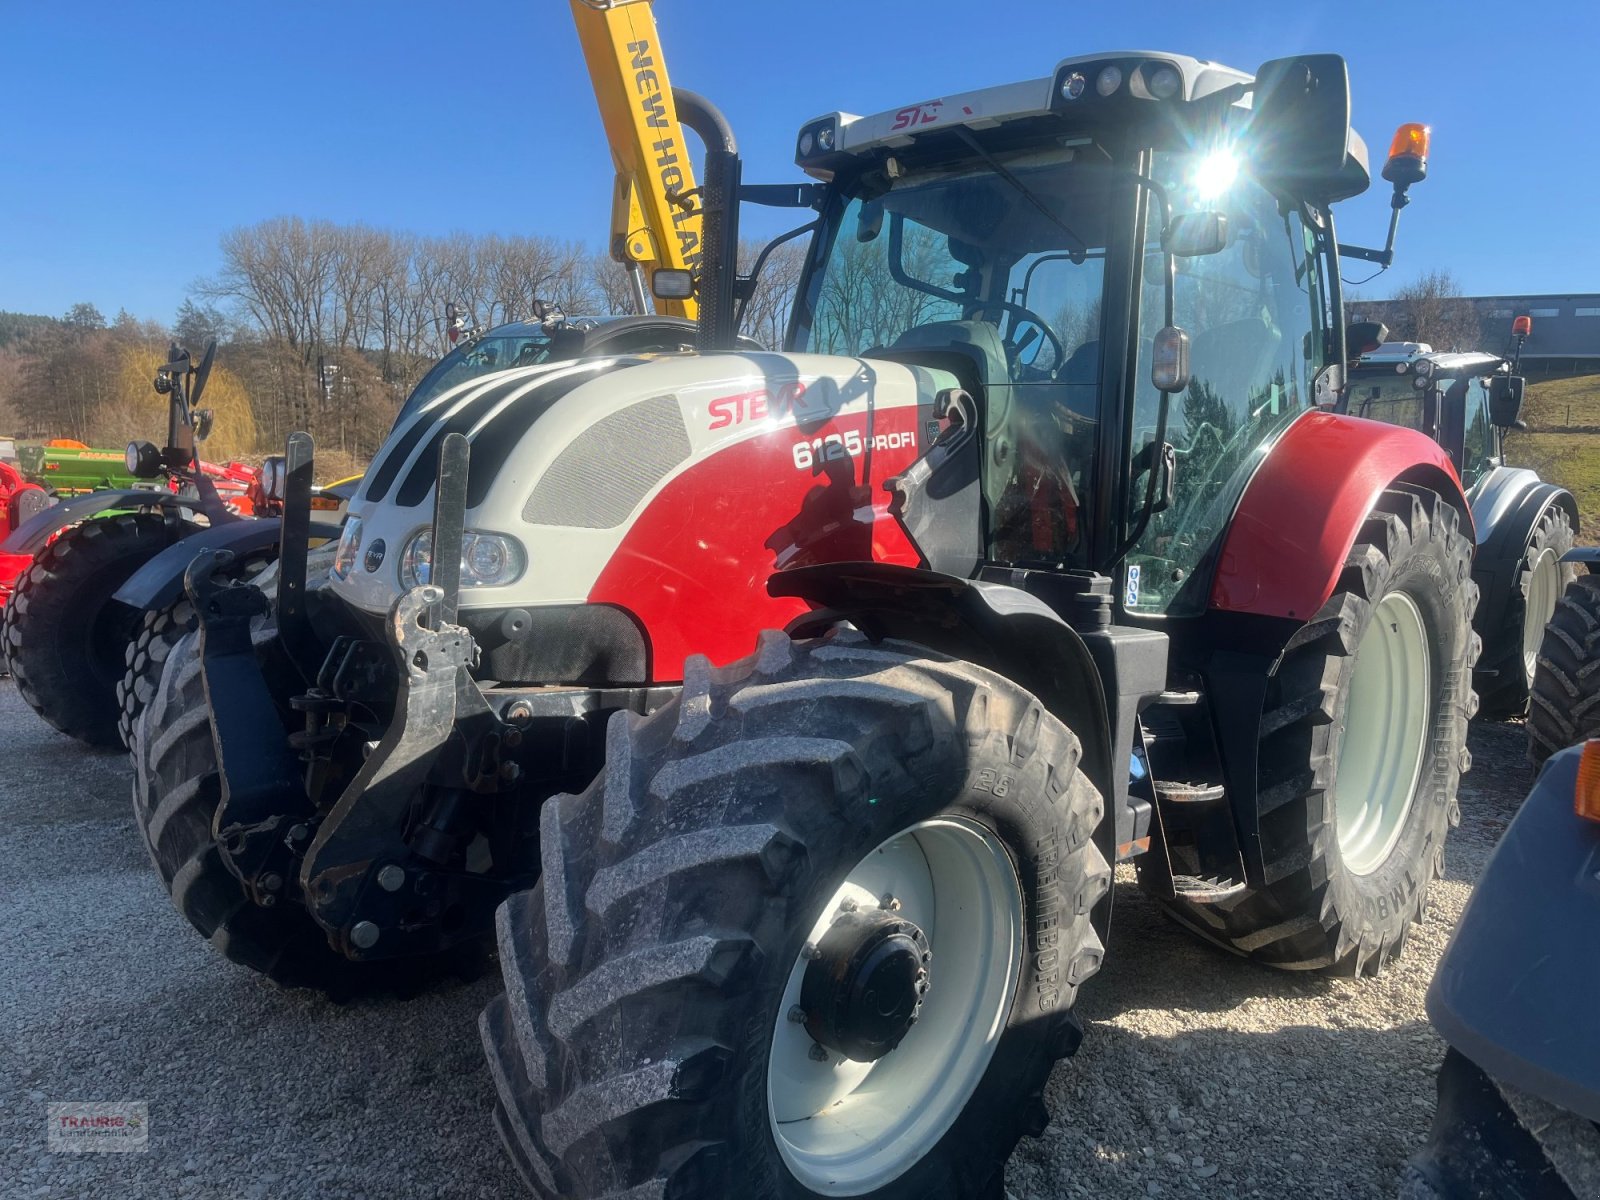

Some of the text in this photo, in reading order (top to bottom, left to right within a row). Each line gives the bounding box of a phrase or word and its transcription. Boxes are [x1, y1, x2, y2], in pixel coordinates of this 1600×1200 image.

[627, 40, 670, 128] NEW
[792, 430, 916, 470] 6125 PROFI
[1036, 826, 1060, 1012] TRELLEBORG
